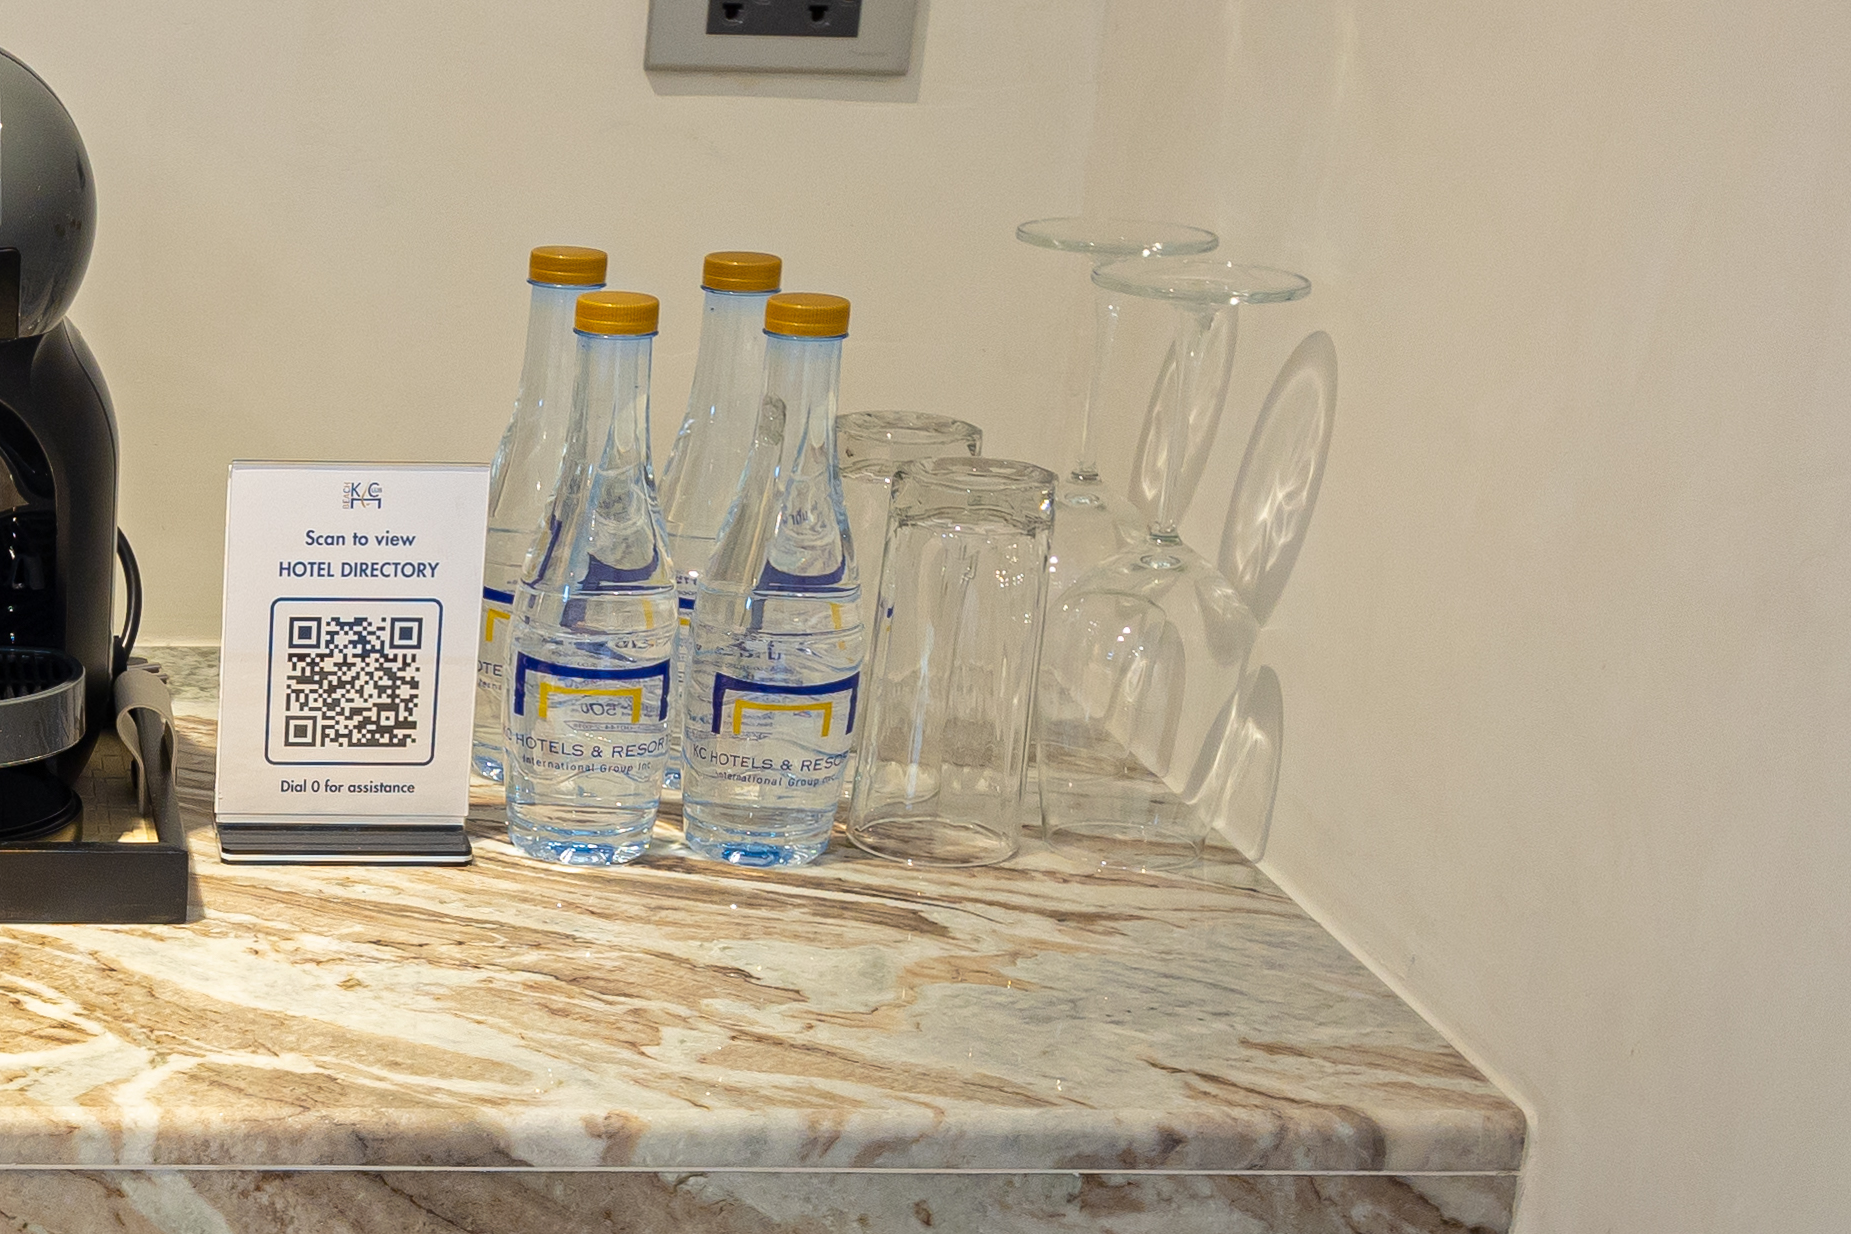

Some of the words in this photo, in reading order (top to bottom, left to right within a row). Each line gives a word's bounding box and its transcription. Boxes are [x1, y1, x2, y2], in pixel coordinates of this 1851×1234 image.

[305, 530, 346, 546] Scan
[353, 532, 369, 546] to
[375, 530, 416, 546] view
[279, 561, 335, 577] HOTEL
[341, 562, 440, 578] DIRECTORY
[515, 732, 585, 757] HOTELS
[591, 745, 603, 758] &
[522, 754, 596, 773] International
[599, 763, 634, 775] Group
[693, 743, 707, 760] KC
[710, 750, 774, 770] HOTELS
[780, 759, 793, 771] &
[280, 779, 307, 793] Dial
[311, 780, 321, 793] 0
[324, 778, 344, 793] for
[347, 780, 415, 793] assistance
[787, 778, 819, 787] Group
